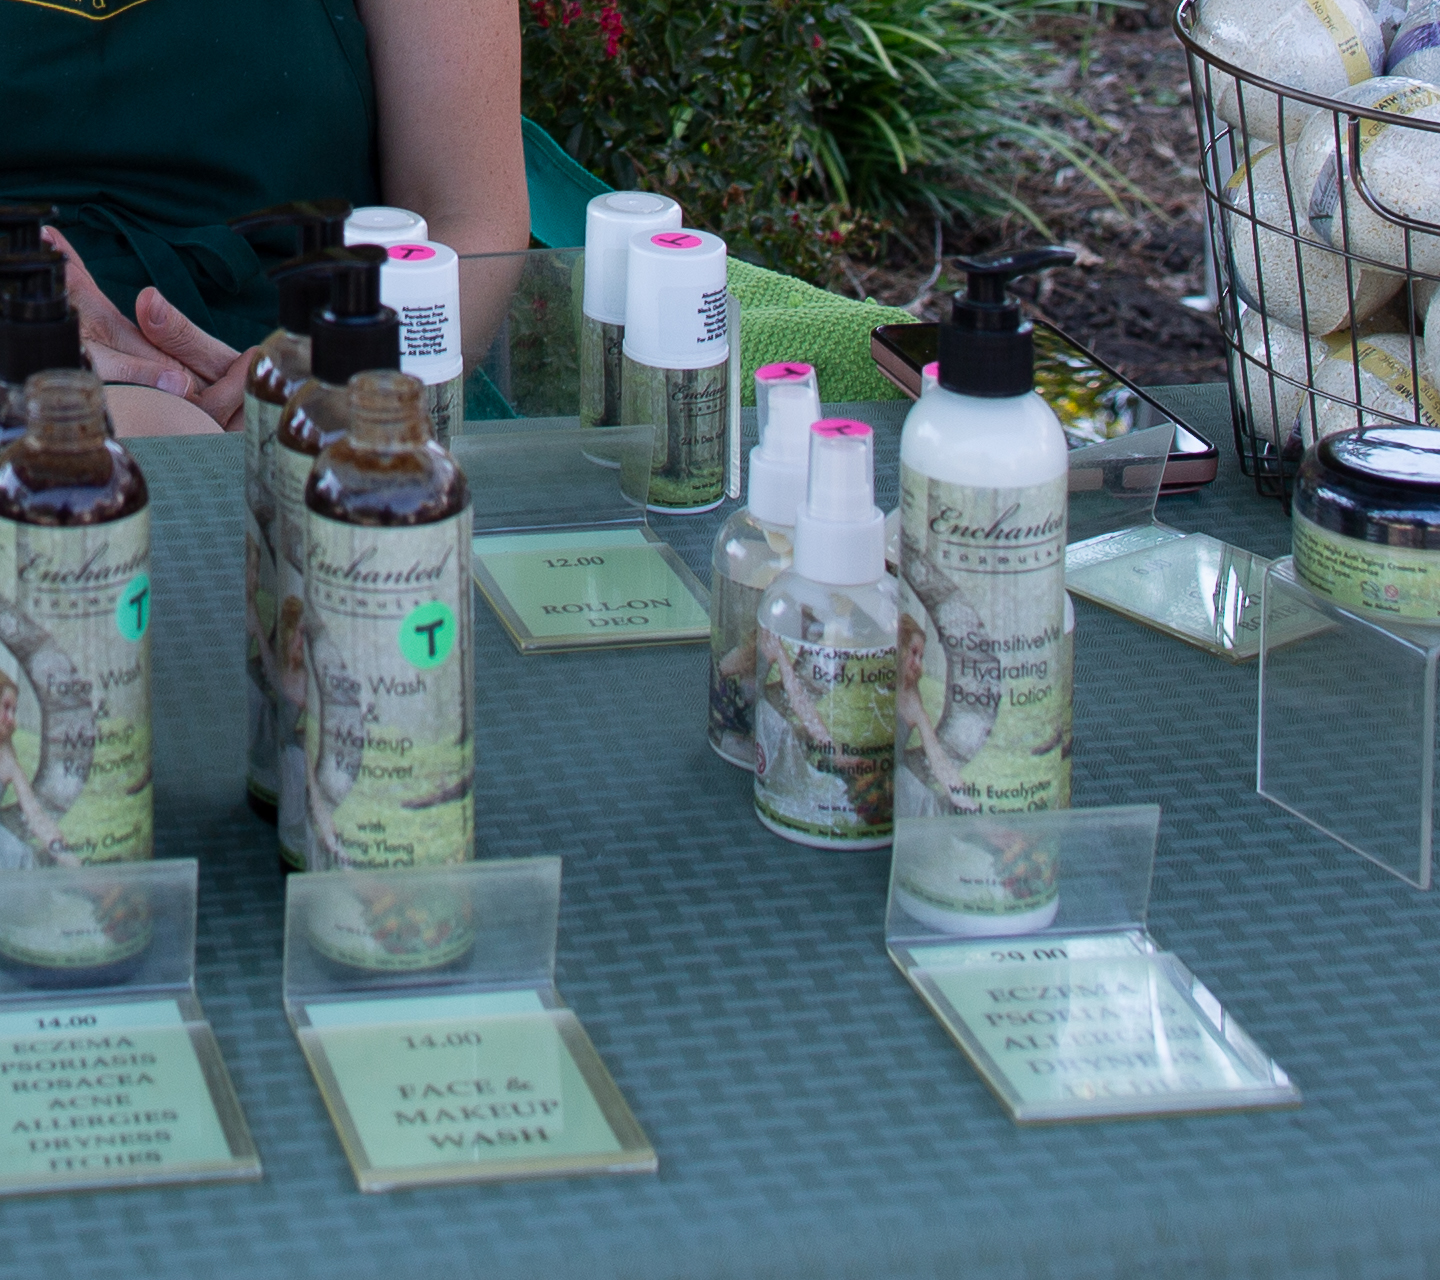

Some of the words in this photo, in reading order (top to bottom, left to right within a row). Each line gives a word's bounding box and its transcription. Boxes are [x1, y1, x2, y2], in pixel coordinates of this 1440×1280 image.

[543, 556, 604, 569] 12.00
[130, 588, 148, 631] T
[541, 598, 672, 615] ROLL-ON
[588, 616, 649, 628] DEO
[415, 619, 443, 657] T
[812, 665, 854, 684] Body
[861, 668, 896, 684] Lotio
[961, 659, 1048, 683] Hydrating
[369, 674, 427, 695] Wash
[953, 684, 1002, 710] Body
[1010, 685, 1052, 706] Lotion
[336, 726, 413, 757] Makeup
[808, 742, 836, 755] with
[336, 750, 413, 779] Remover
[817, 759, 877, 776] Essential
[948, 783, 980, 798] with
[36, 1015, 97, 1029] 14.00
[12, 1036, 134, 1054] ECZEMA
[405, 1031, 482, 1050] 14.00
[0, 1052, 158, 1074] PSORIASIS
[12, 1073, 155, 1092] ROSACEA
[397, 1079, 496, 1100] FACE
[506, 1077, 534, 1092] &
[48, 1094, 132, 1110] ACNE
[12, 1110, 178, 1133] ALLERGIES
[394, 1100, 559, 1126] MAKEUP
[29, 1130, 172, 1152] DRYNESS
[428, 1127, 549, 1150] WASH
